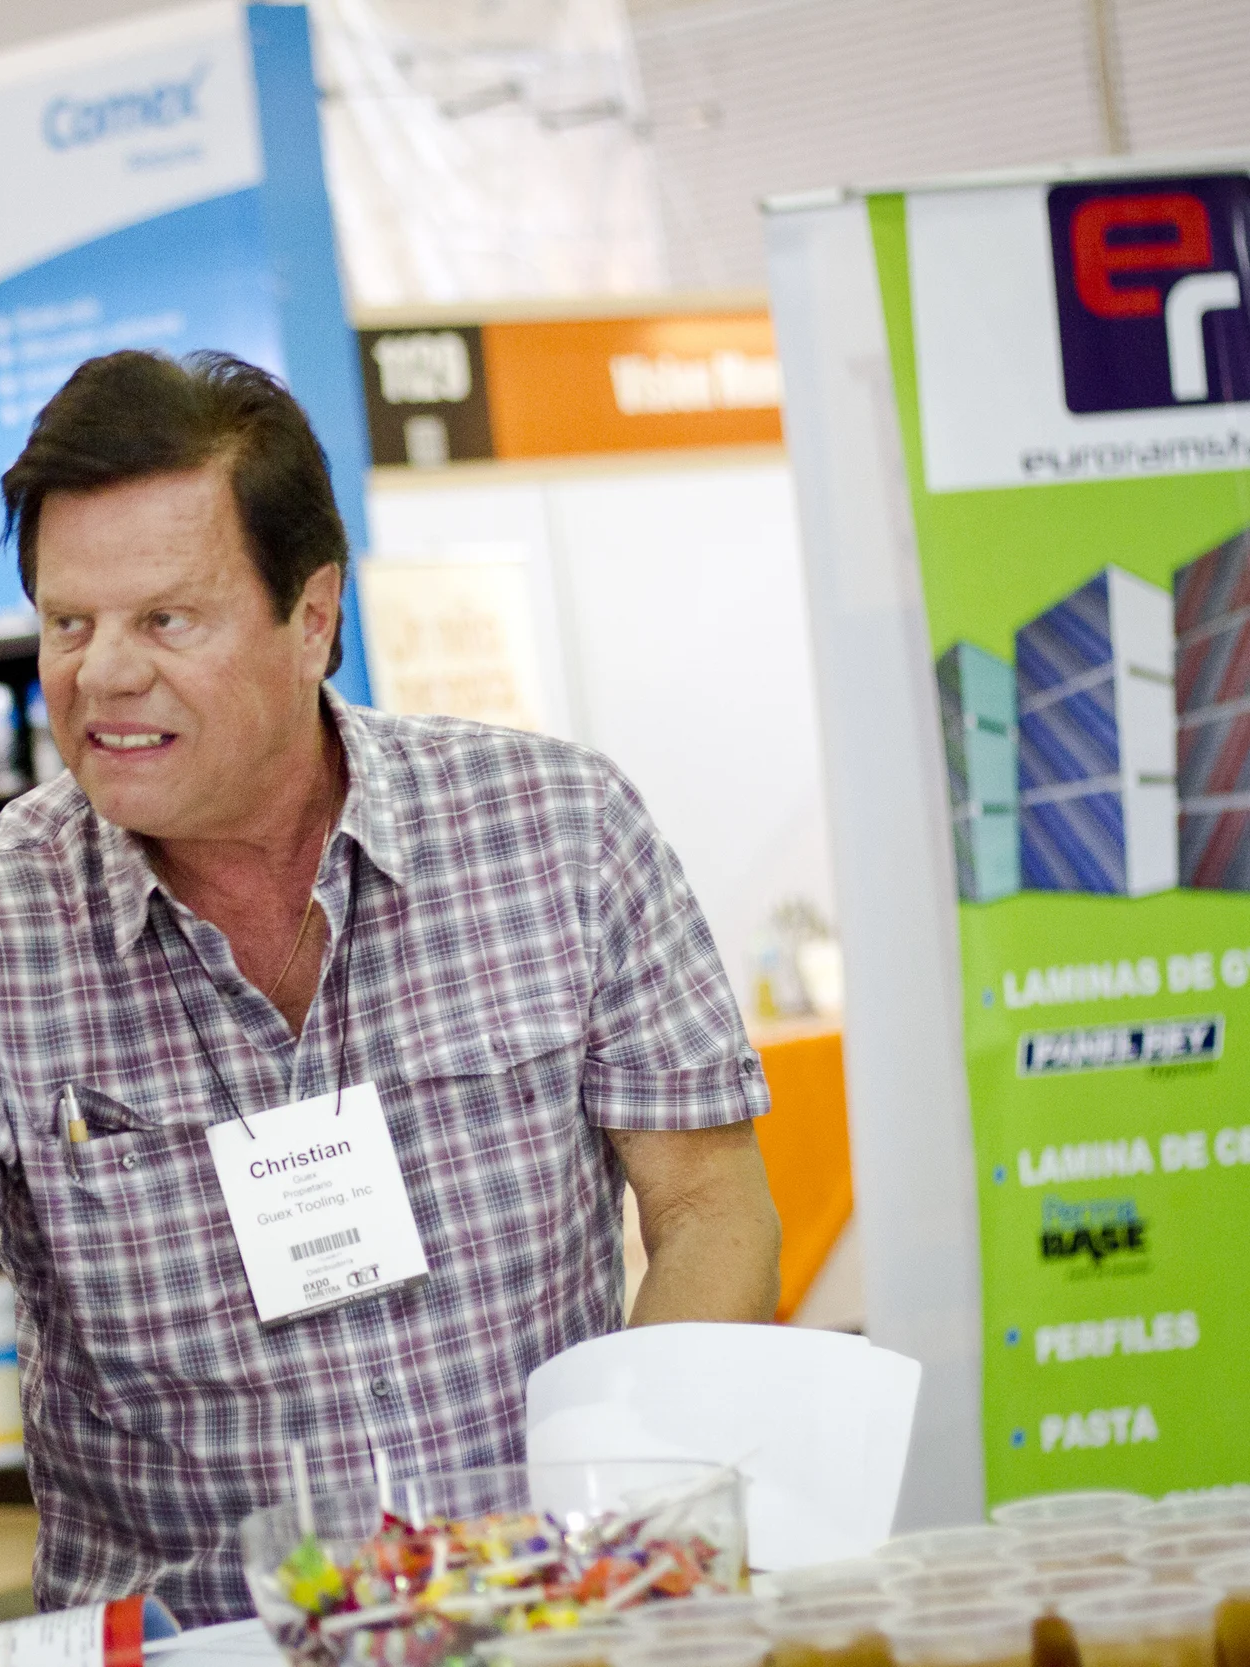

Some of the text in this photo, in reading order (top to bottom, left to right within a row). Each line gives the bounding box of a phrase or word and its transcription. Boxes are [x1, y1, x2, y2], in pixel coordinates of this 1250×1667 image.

[1004, 956, 1161, 1009] LAMINAS
[1167, 951, 1215, 993] DE
[250, 1140, 352, 1179] Christian
[292, 1172, 318, 1185] Guex
[1018, 1135, 1154, 1187] LAMINA
[1160, 1130, 1209, 1173] DE
[257, 1209, 293, 1226] Guex
[352, 1186, 374, 1199] Inc
[283, 1180, 333, 1199] Propietario
[302, 1277, 330, 1293] expo
[1035, 1309, 1200, 1364] PERFILES
[1040, 1405, 1158, 1453] PASTA
